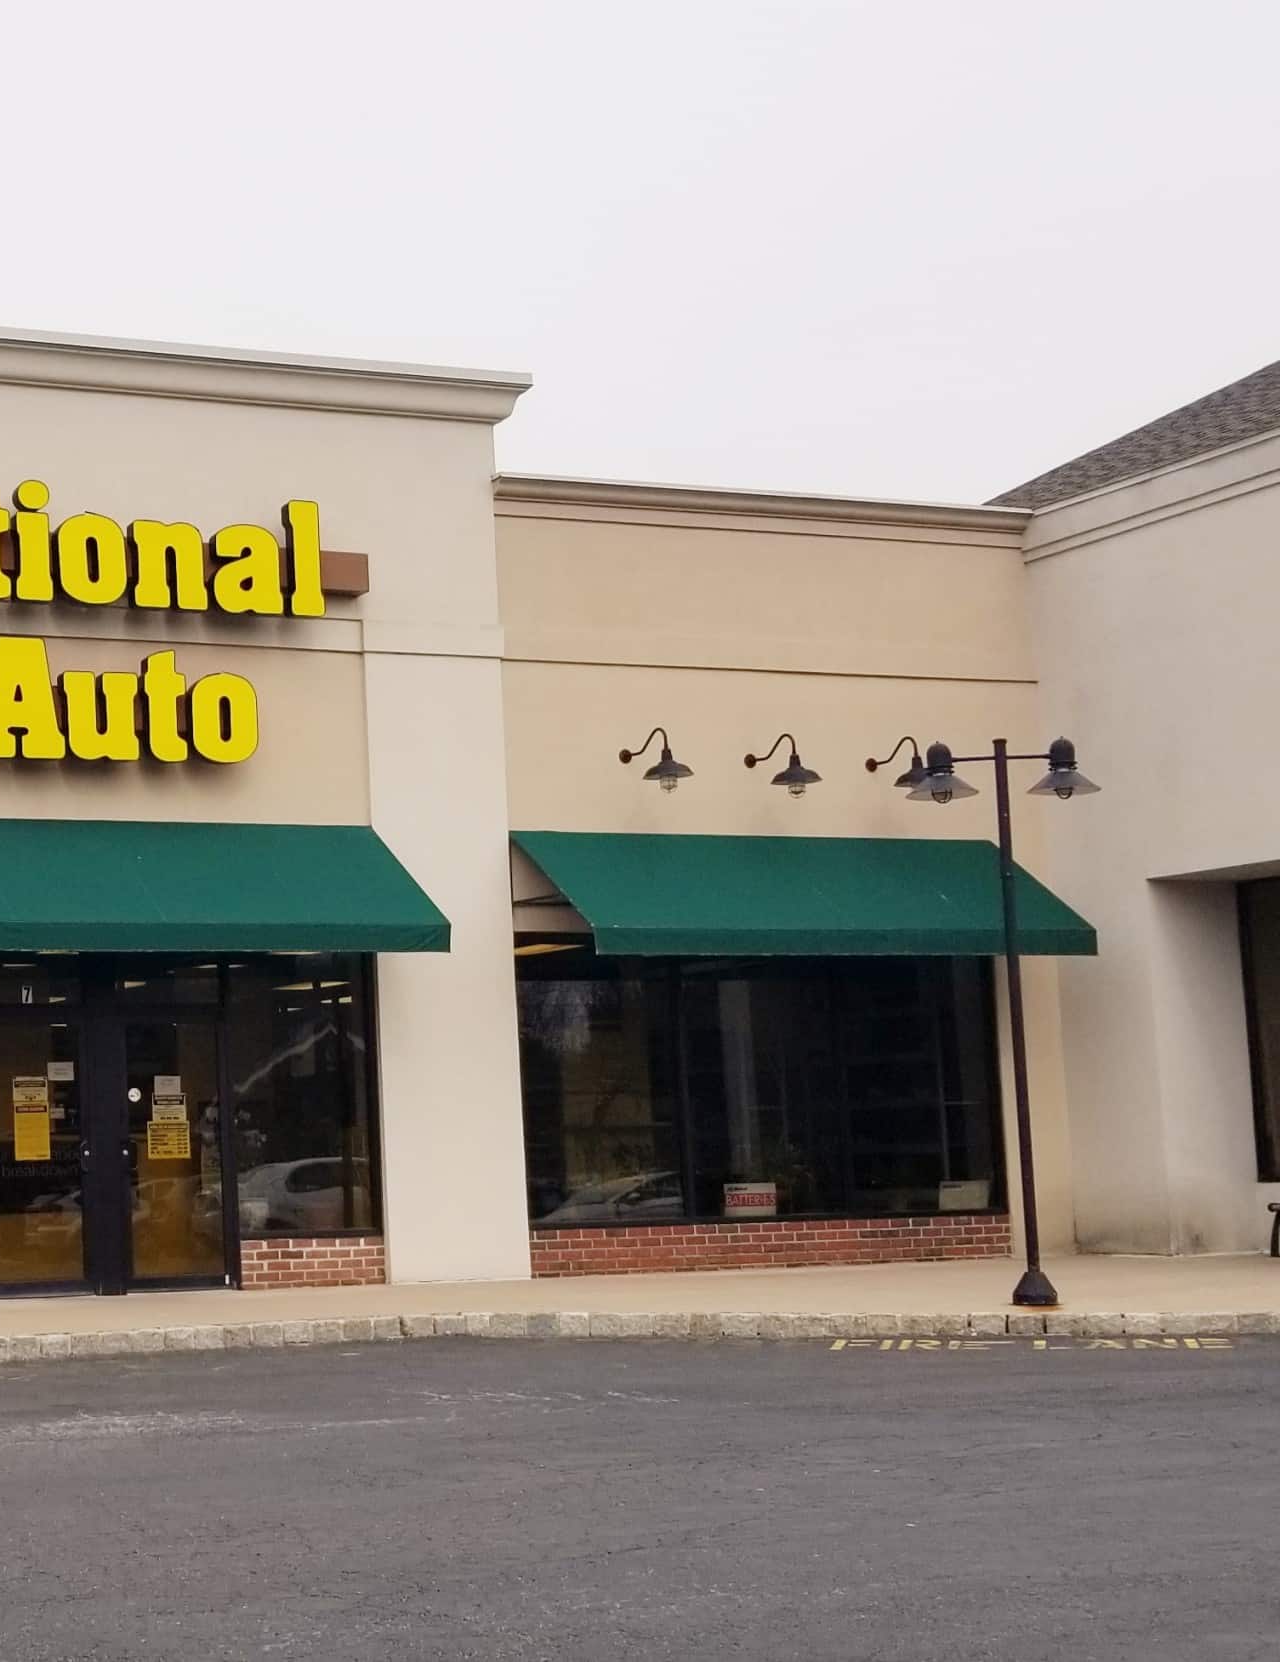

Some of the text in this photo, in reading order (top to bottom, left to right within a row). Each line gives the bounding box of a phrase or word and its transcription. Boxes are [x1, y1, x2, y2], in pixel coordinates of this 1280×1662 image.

[725, 1192, 776, 1206] BATTERIES
[829, 1337, 1235, 1351] FIRE LANE
